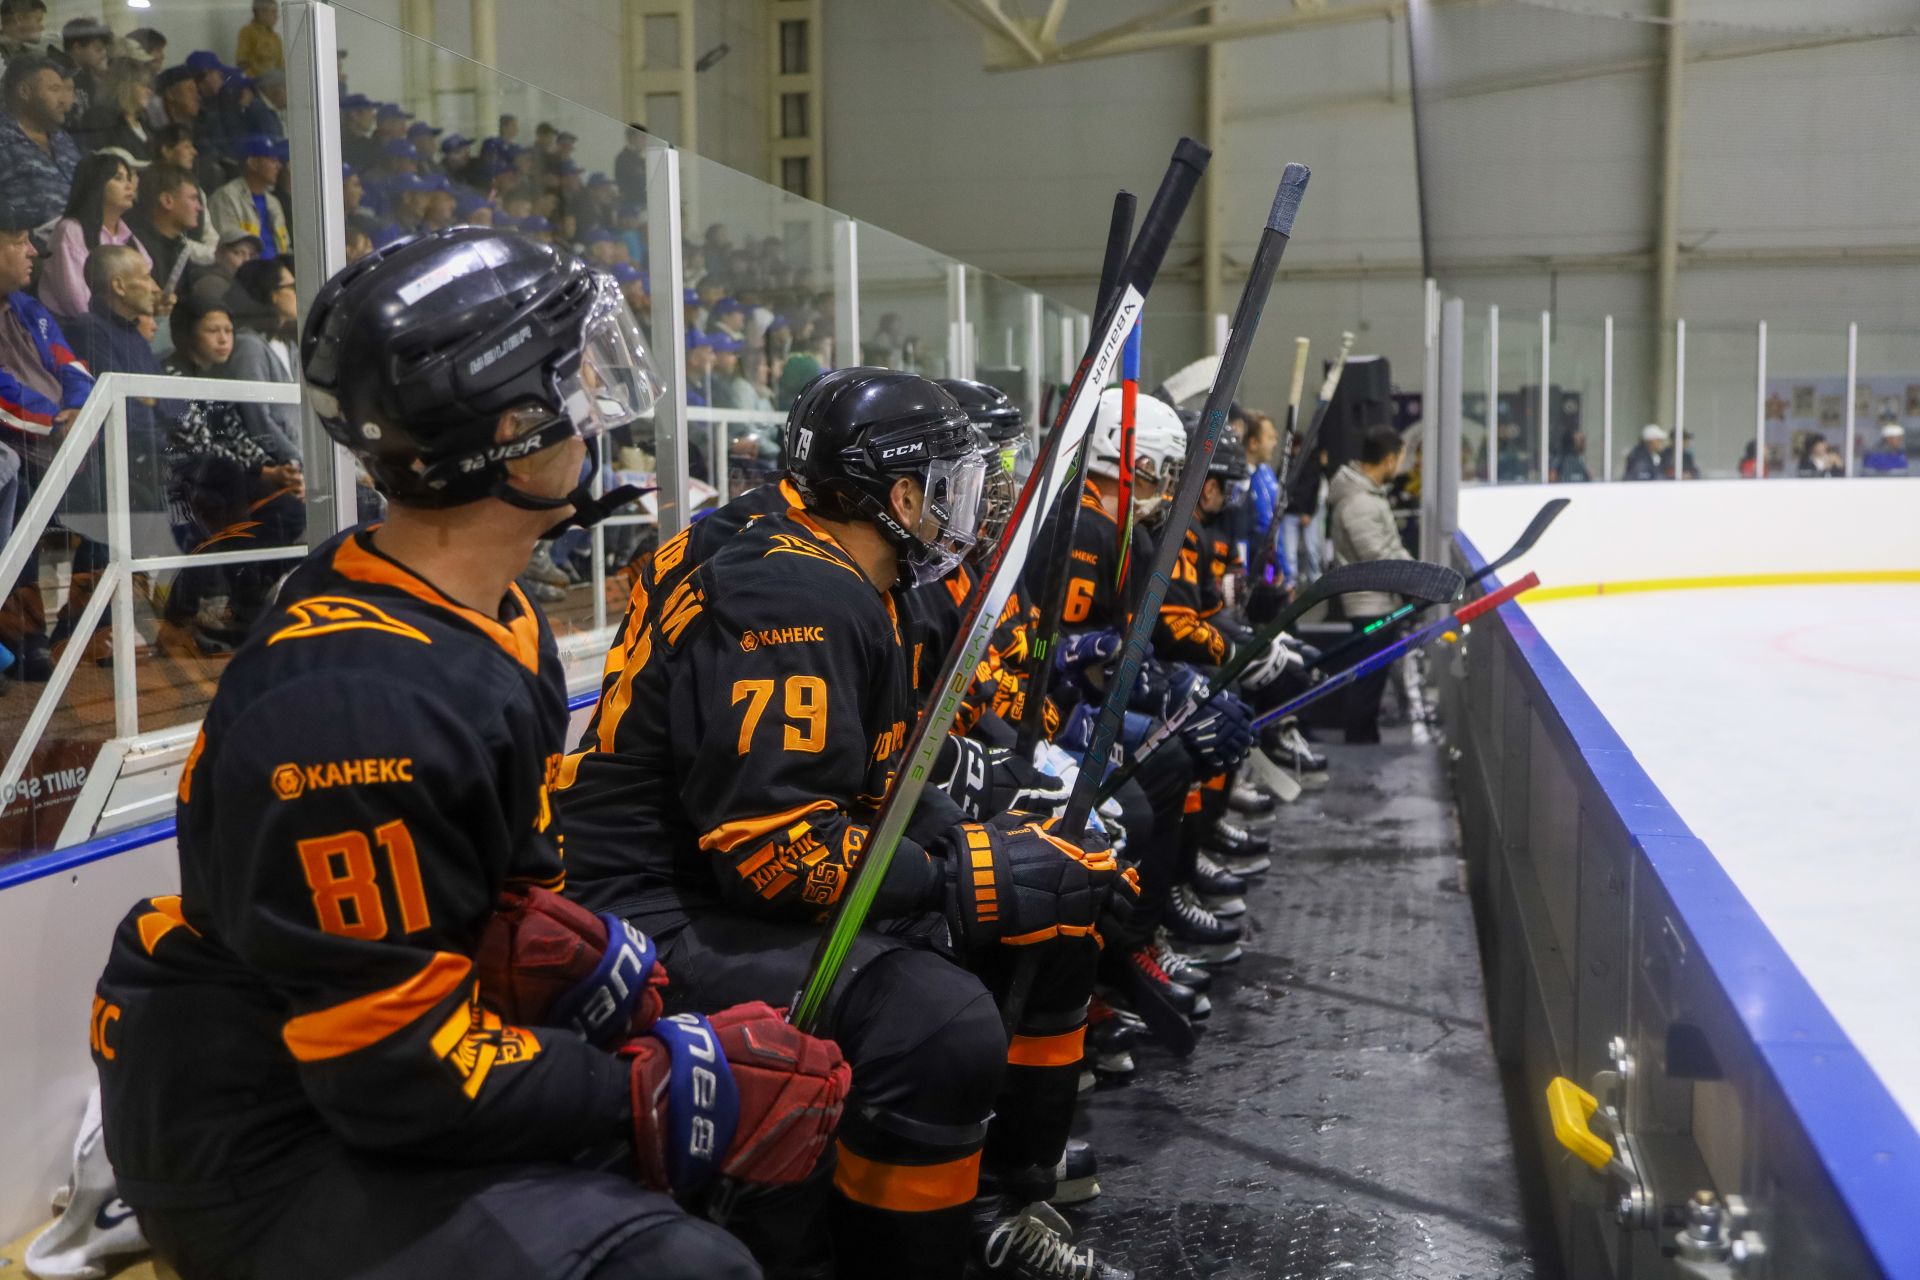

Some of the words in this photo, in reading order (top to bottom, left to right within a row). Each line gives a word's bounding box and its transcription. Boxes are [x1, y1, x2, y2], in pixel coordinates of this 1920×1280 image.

[795, 427, 814, 461] 79
[882, 441, 924, 459] CCM
[877, 511, 911, 539] CCM
[930, 504, 950, 521] CCM
[759, 625, 825, 646] КАНЕКС
[731, 675, 829, 756] 79
[307, 758, 414, 789] КАНЕКС
[296, 818, 432, 941] 81
